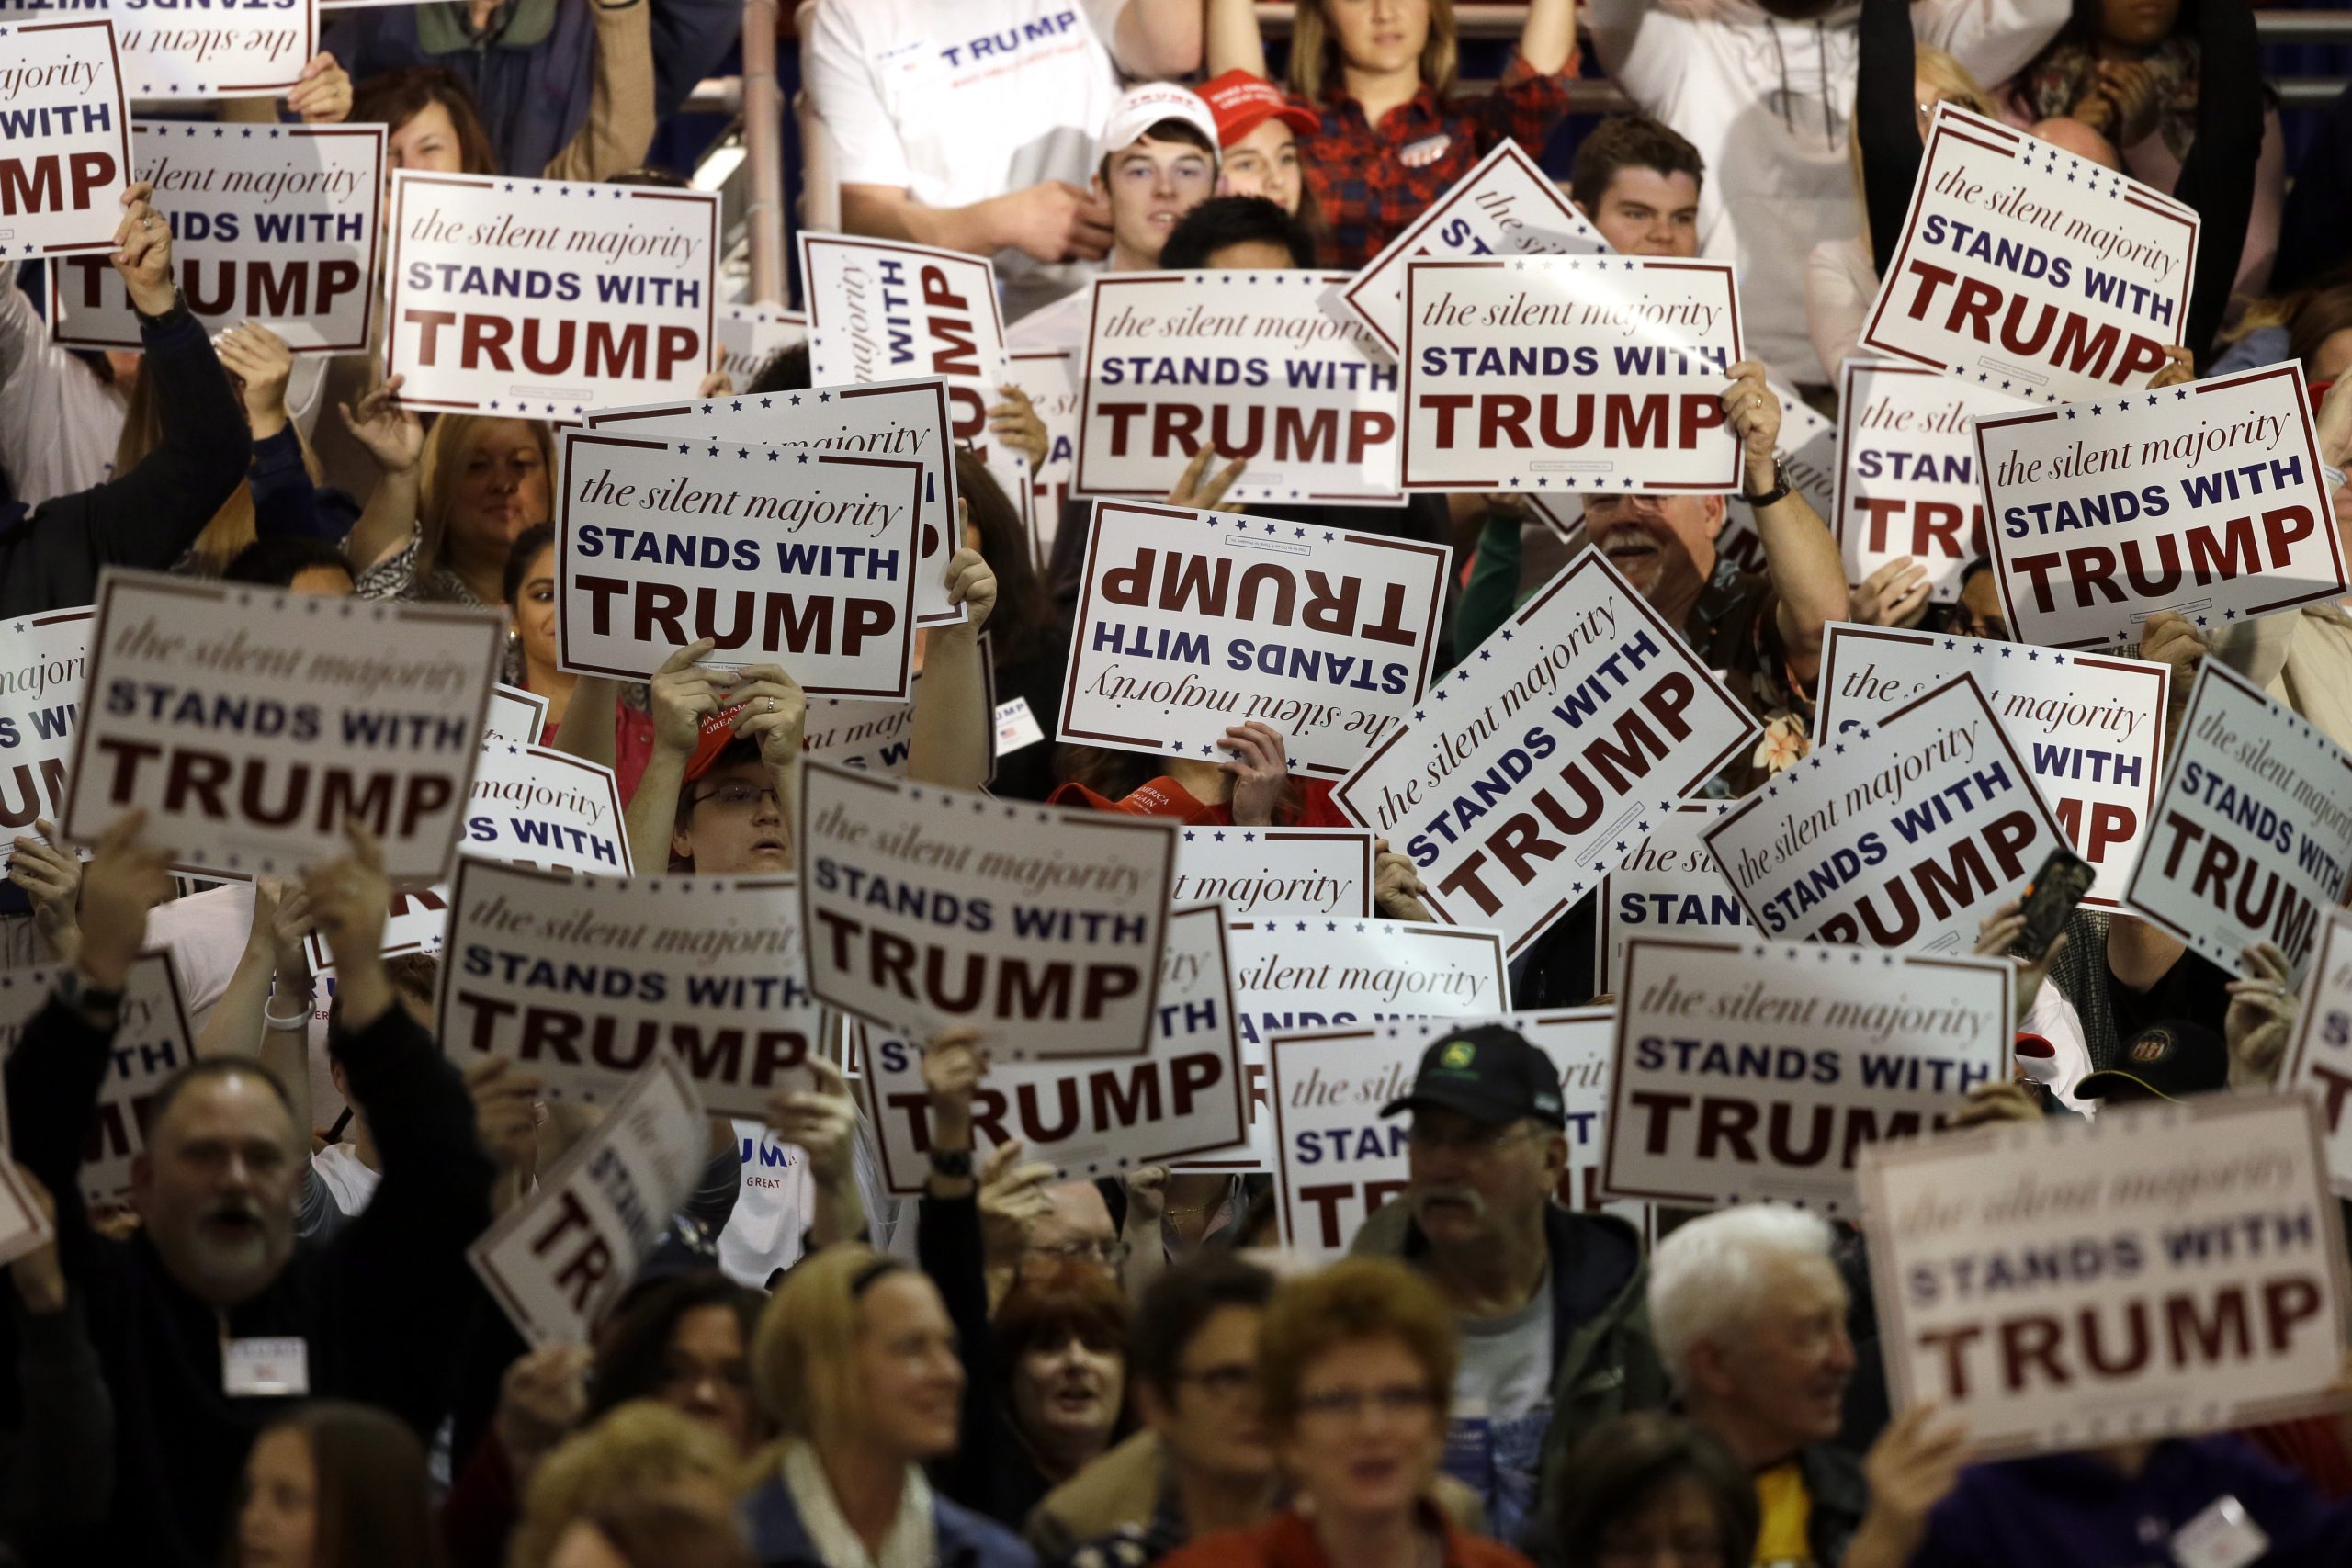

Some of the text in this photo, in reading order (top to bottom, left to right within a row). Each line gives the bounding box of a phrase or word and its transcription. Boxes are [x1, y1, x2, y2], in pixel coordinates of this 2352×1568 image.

[151, 29, 240, 62] silent
[244, 29, 297, 62] the
[940, 11, 1079, 68] TRUMP
[0, 54, 104, 100] ajority
[0, 103, 111, 140] WITH
[220, 163, 366, 203] majority
[1475, 189, 1523, 232] the
[254, 212, 363, 243] WITH
[411, 209, 702, 268] the silent majority
[1934, 165, 2180, 283] the silent majority
[66, 256, 361, 318] TUMP
[407, 261, 700, 308] STANDS WITH
[1922, 214, 2174, 327] STANDS WITH
[879, 259, 915, 365] WITH
[1103, 305, 1155, 339] the
[1159, 305, 1249, 340] silent
[1422, 292, 1723, 337] the silent majority
[1908, 259, 2167, 387] TRUMP
[404, 309, 700, 381] TRUMP
[921, 265, 989, 442] UMP
[1099, 356, 1397, 392] STANDS WITH
[1421, 345, 1727, 377] STANDS WITH
[1096, 402, 1396, 464] TRUMP
[1419, 393, 1725, 450] TRUMP
[1859, 396, 1913, 434] the
[1857, 449, 1974, 485] STAN
[1996, 410, 2290, 488] the silent majority
[578, 468, 904, 538] the silent majority
[2004, 484, 2170, 538] STANDS
[2180, 455, 2304, 509] WITH
[576, 524, 899, 581] STANDS WITH
[2010, 504, 2316, 615] TRUMP
[575, 574, 897, 657] TRUMP
[1101, 546, 1418, 648] TRUMP
[1092, 621, 1410, 695] STANDS WITH
[1085, 663, 1240, 716] majority
[1242, 692, 1342, 738] silent
[1378, 596, 1618, 830] the silent majority
[1840, 663, 2147, 743] the majority
[1406, 629, 1661, 866] STANDS WITH
[2032, 742, 2142, 787] WITH
[2197, 710, 2236, 749] the
[2238, 736, 2295, 791] silent
[471, 776, 605, 826] majority
[1437, 671, 1695, 917] TRUMP
[1737, 846, 1772, 889] the
[1774, 810, 1841, 868] silent
[1843, 720, 1979, 815] majority
[510, 817, 616, 864] WITH
[814, 801, 1155, 905] the silent majority
[1619, 836, 1676, 874] the
[1761, 831, 1888, 933] STANDS
[1891, 761, 2014, 846] WITH
[2179, 761, 2294, 855] STANDS
[2297, 832, 2345, 901] WITH
[816, 857, 1147, 946] STANDS WITH
[1193, 868, 1352, 913] majority
[1619, 892, 1746, 928] STAN
[469, 894, 536, 932] the
[544, 908, 648, 951] silent
[463, 944, 810, 1009] STANDS WITH
[815, 907, 1142, 1022] TRUMP
[1236, 954, 1489, 1007] silent majority
[457, 988, 809, 1089] TRUMP
[1638, 974, 1992, 1049] the silent majority
[1290, 1066, 1340, 1109] the
[1635, 1035, 1841, 1084] STANDS
[1859, 1050, 1990, 1094] WITH
[888, 1050, 1223, 1155] TRUMP
[746, 1176, 781, 1189] GREAT
[1911, 1210, 2315, 1310] STANDS WITH
[1918, 1276, 2322, 1399] TRUMP
